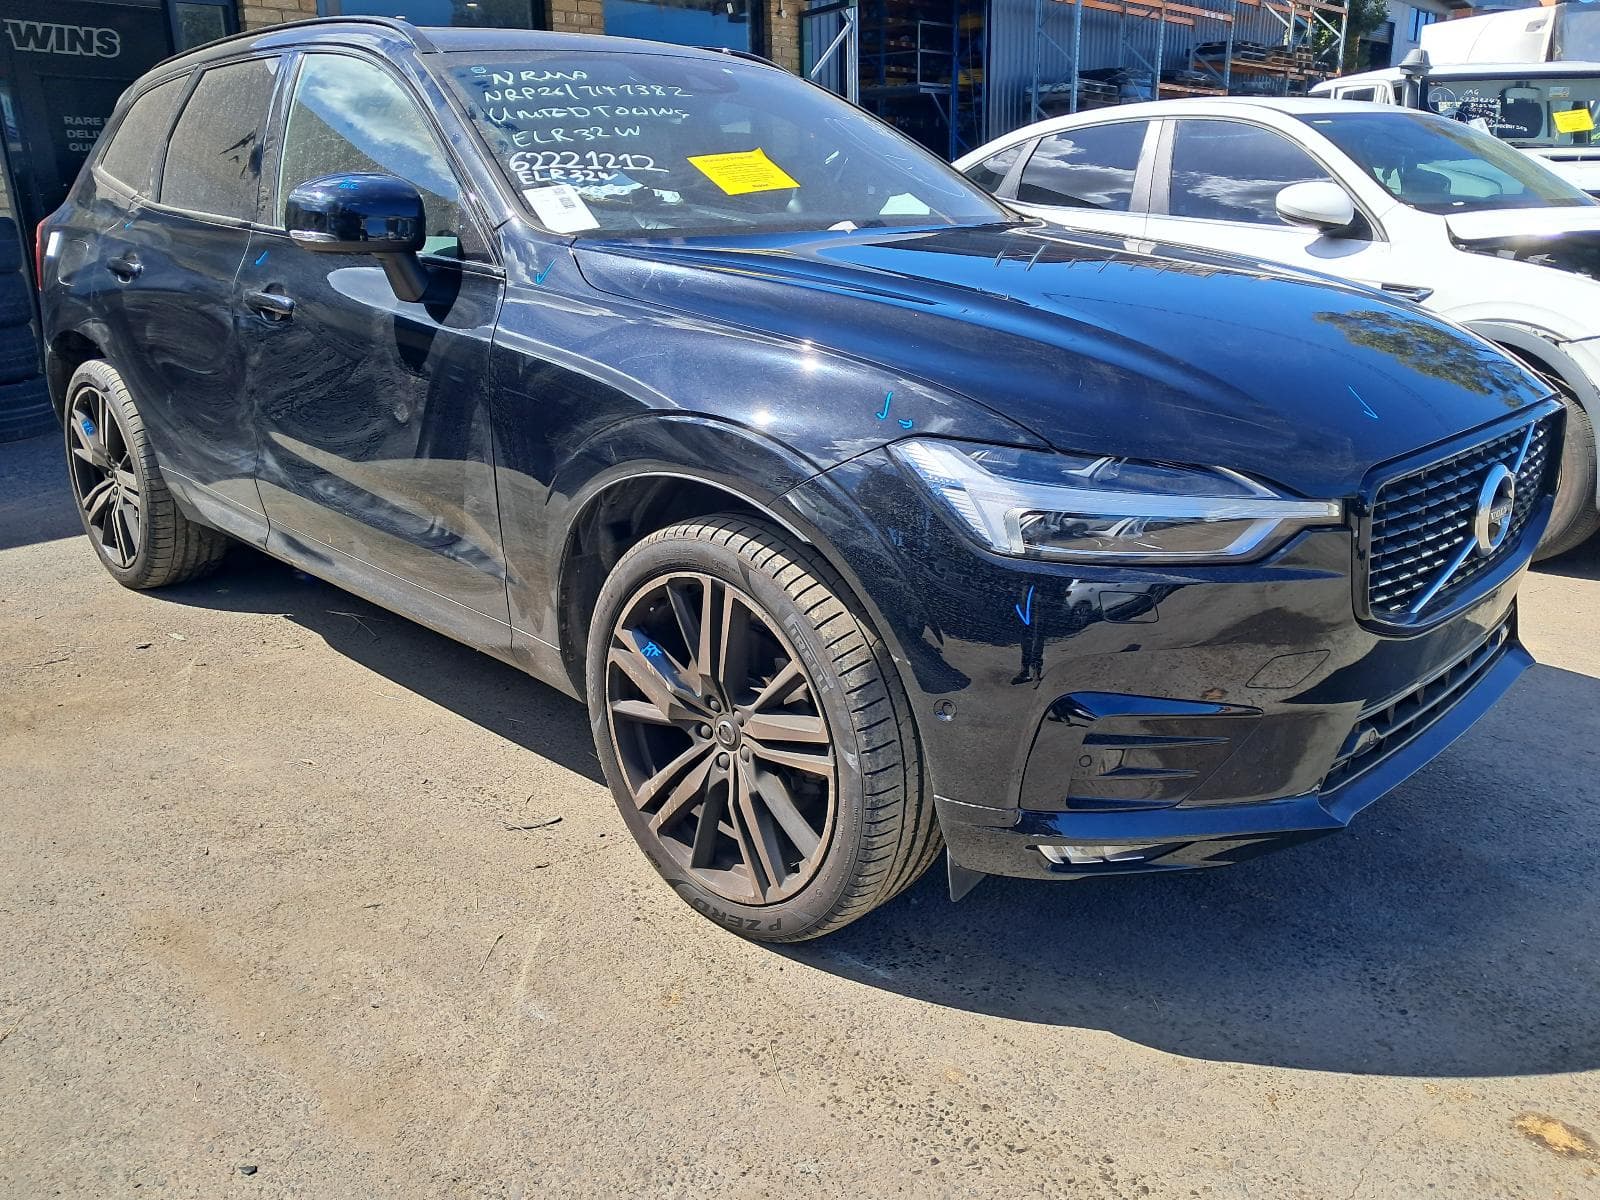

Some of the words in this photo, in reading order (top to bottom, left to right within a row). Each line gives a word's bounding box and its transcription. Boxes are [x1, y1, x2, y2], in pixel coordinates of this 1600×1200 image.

[3, 19, 121, 58] WINS
[63, 116, 102, 126] RARE
[509, 150, 670, 173] 62221212
